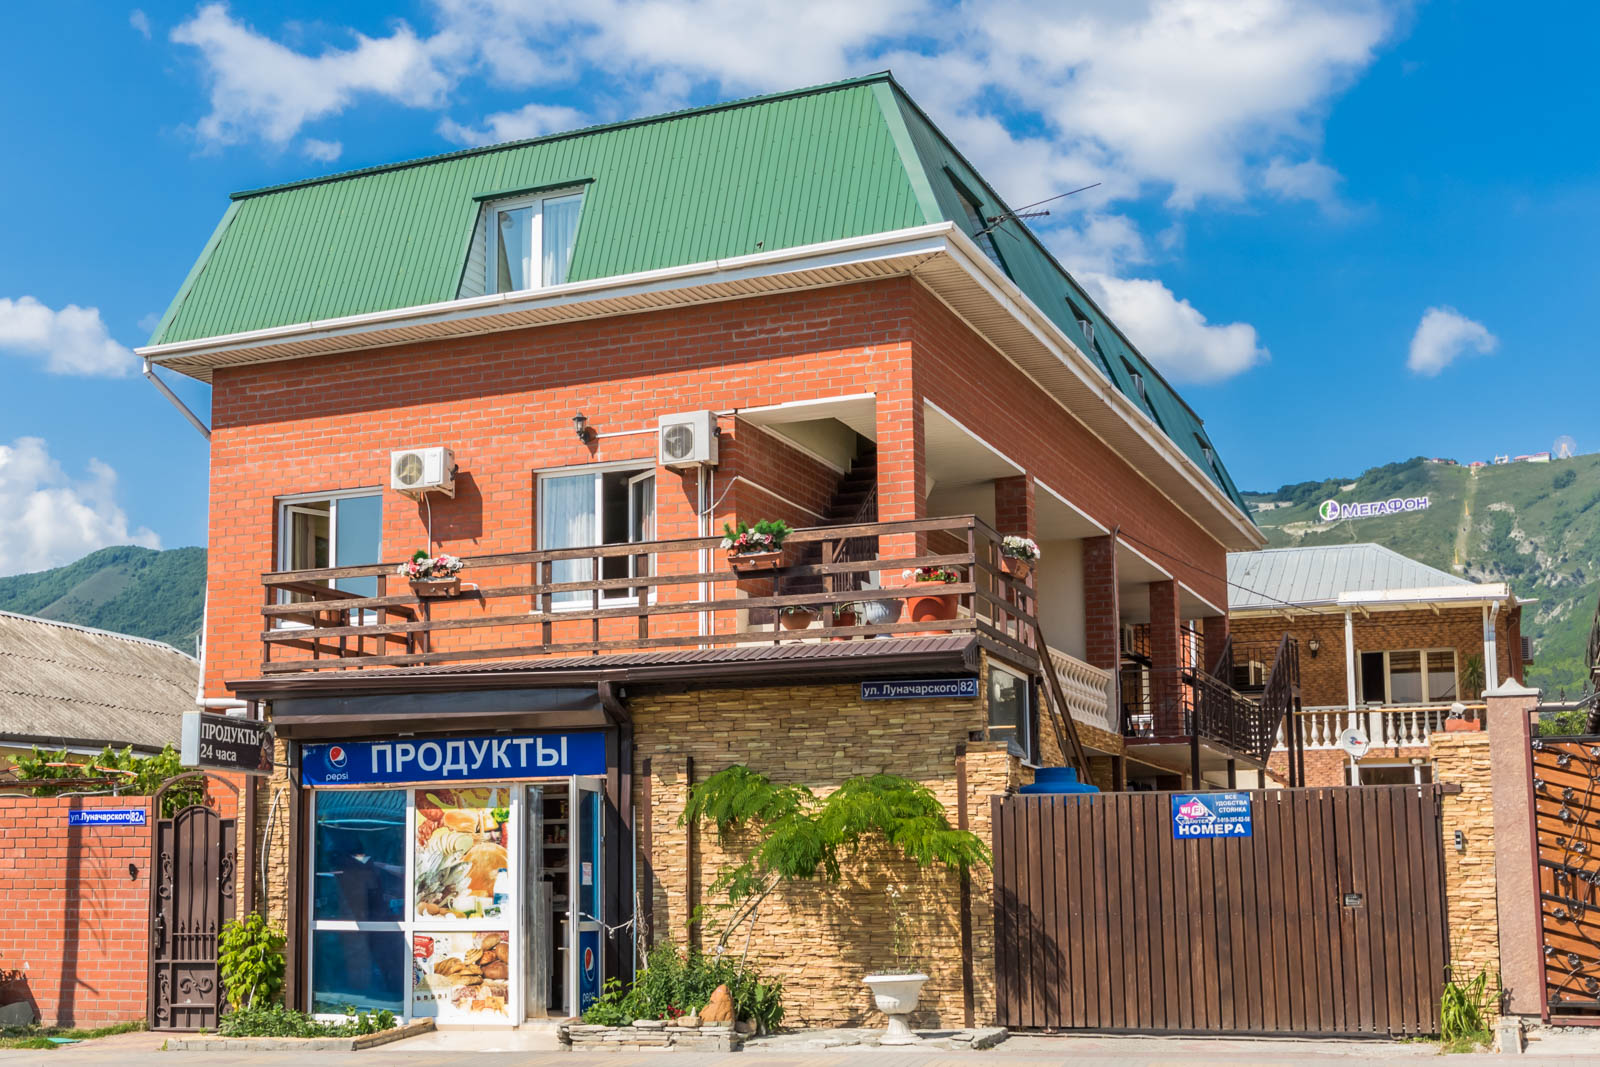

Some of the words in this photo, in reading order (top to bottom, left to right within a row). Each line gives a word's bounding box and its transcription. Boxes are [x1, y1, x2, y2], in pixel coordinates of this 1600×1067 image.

[864, 687, 880, 697] ул.
[883, 683, 958, 697] Луначарского
[960, 681, 974, 692] 82
[201, 722, 260, 746] ПРОДУКТЫ
[200, 743, 213, 759] 24
[215, 749, 237, 762] часа
[371, 736, 568, 776] ПРОДУКТЫ
[326, 771, 349, 782] pepsi
[1178, 823, 1246, 835] НОМЕРА
